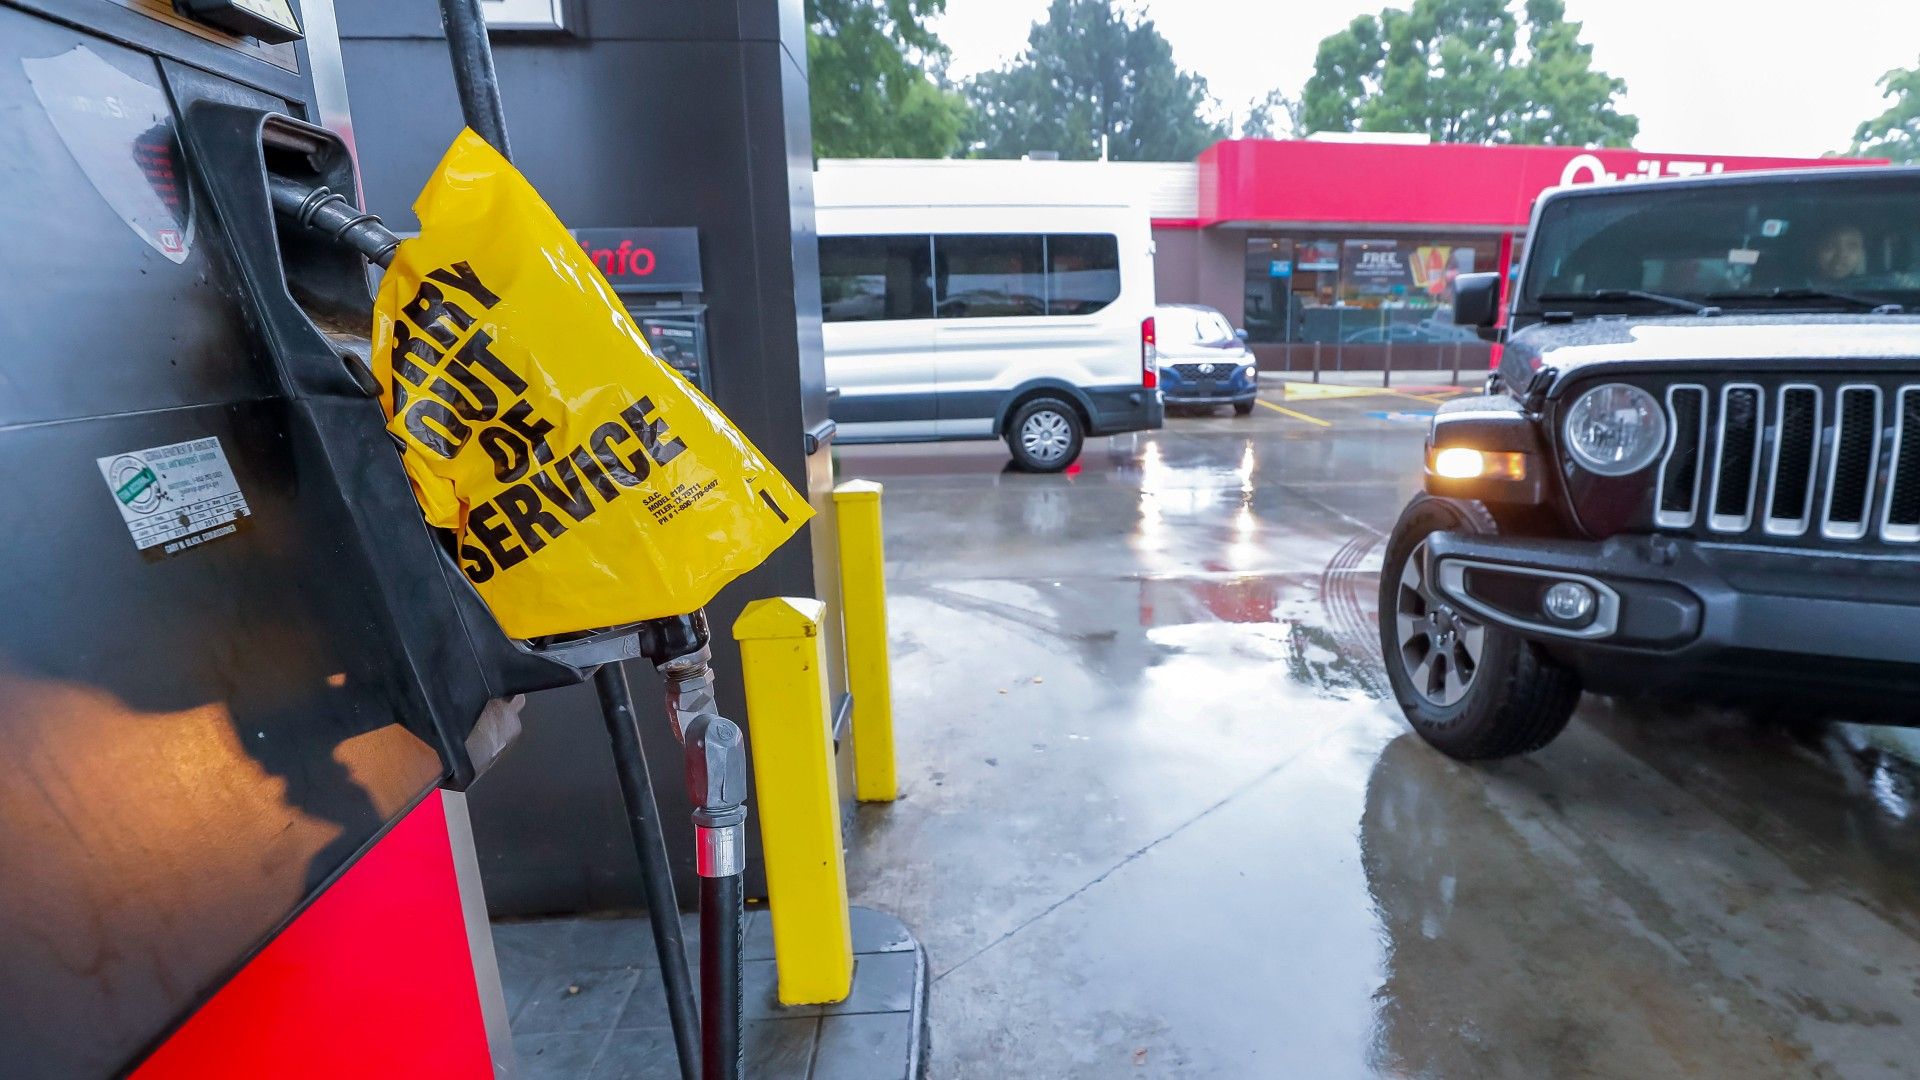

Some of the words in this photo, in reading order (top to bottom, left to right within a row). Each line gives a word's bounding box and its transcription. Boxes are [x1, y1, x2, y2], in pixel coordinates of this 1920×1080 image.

[1362, 251, 1398, 263] FREE
[405, 328, 529, 459] OUT
[478, 399, 556, 484] OF
[462, 395, 688, 583] SERVICE
[648, 495, 671, 512] MODEL
[652, 503, 676, 519] TYLER,
